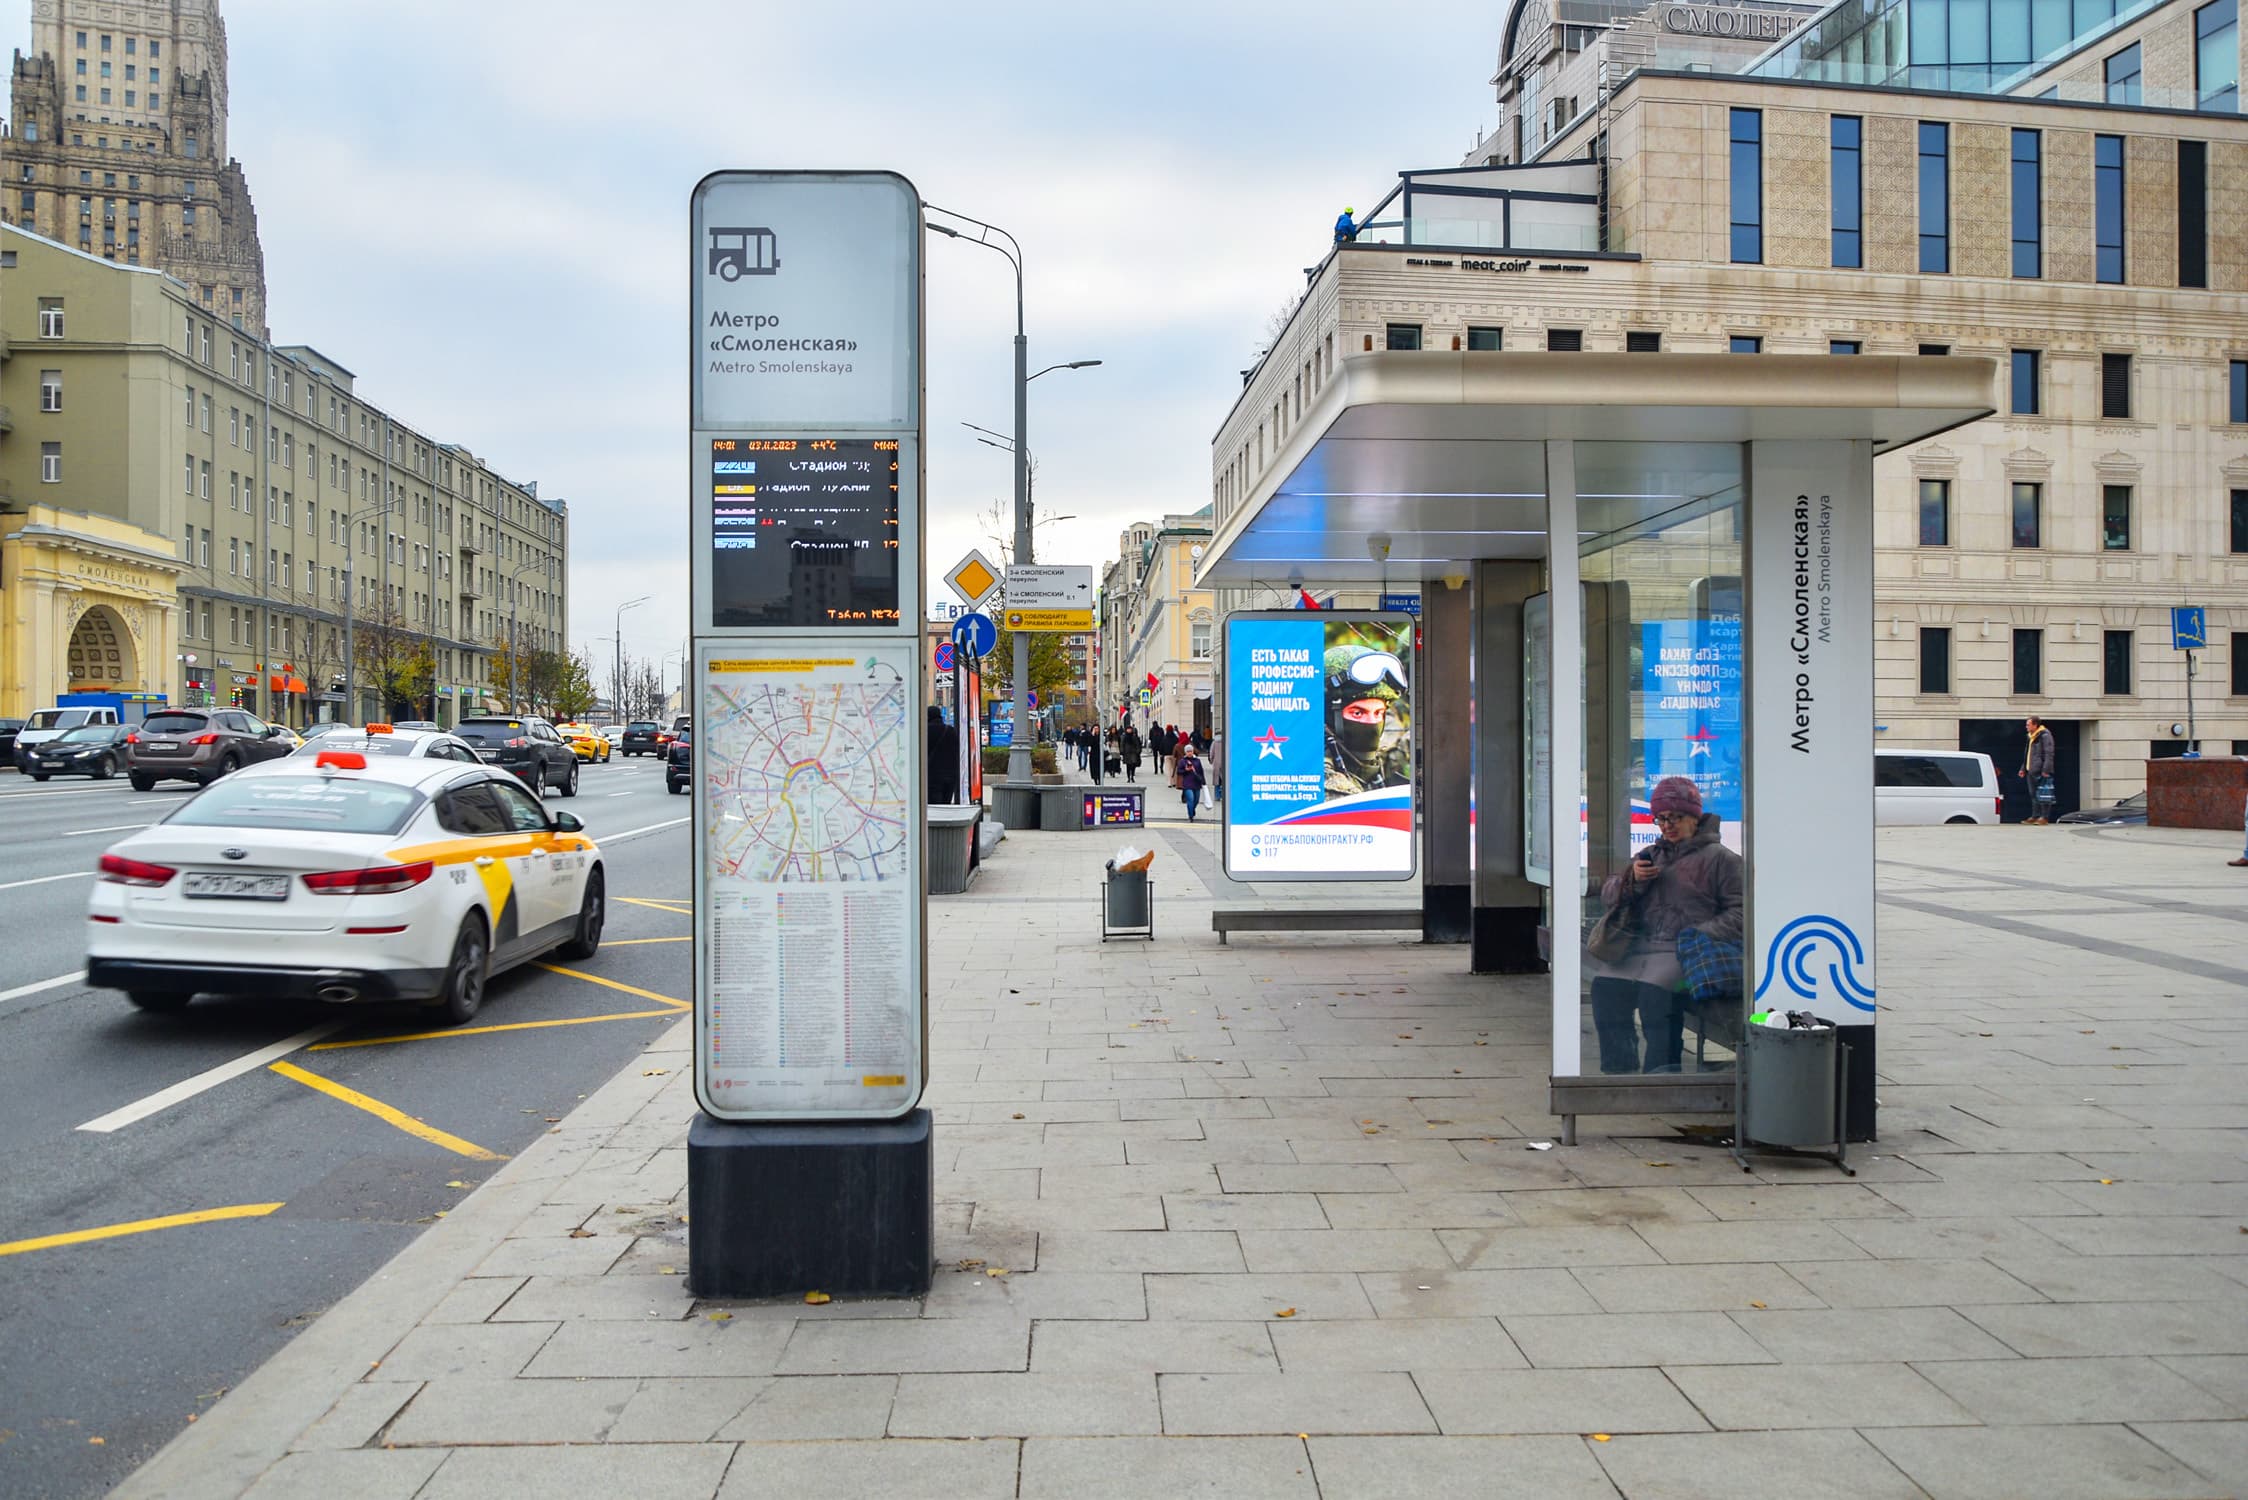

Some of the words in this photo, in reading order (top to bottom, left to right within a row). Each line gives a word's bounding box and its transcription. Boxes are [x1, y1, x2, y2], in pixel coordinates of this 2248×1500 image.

[709, 311, 780, 331] Метро
[710, 335, 858, 351] «Смоленская»
[709, 361, 755, 373] Metro
[759, 360, 853, 375] Smolenskaya
[1817, 495, 1833, 592] Smolenskaya
[78, 564, 150, 586] СМОЛЕНСКАЯ
[1790, 494, 1810, 666] «Смоленская»
[949, 605, 968, 618] ВТ
[1818, 596, 1832, 643] Metro
[1252, 649, 1277, 662] ЕСТЬ
[1278, 649, 1310, 662] ТАКАЯ
[1252, 665, 1320, 678] ПРОФЕССИЯ-
[1252, 681, 1294, 696] РОДИНУ
[1251, 697, 1311, 712] ЗАЩИЩАТЬ
[1790, 673, 1814, 754] Метро
[1264, 834, 1374, 845] СЛУЖБАПОКОНТРАКТУ.РФ
[1264, 848, 1278, 857] 117
